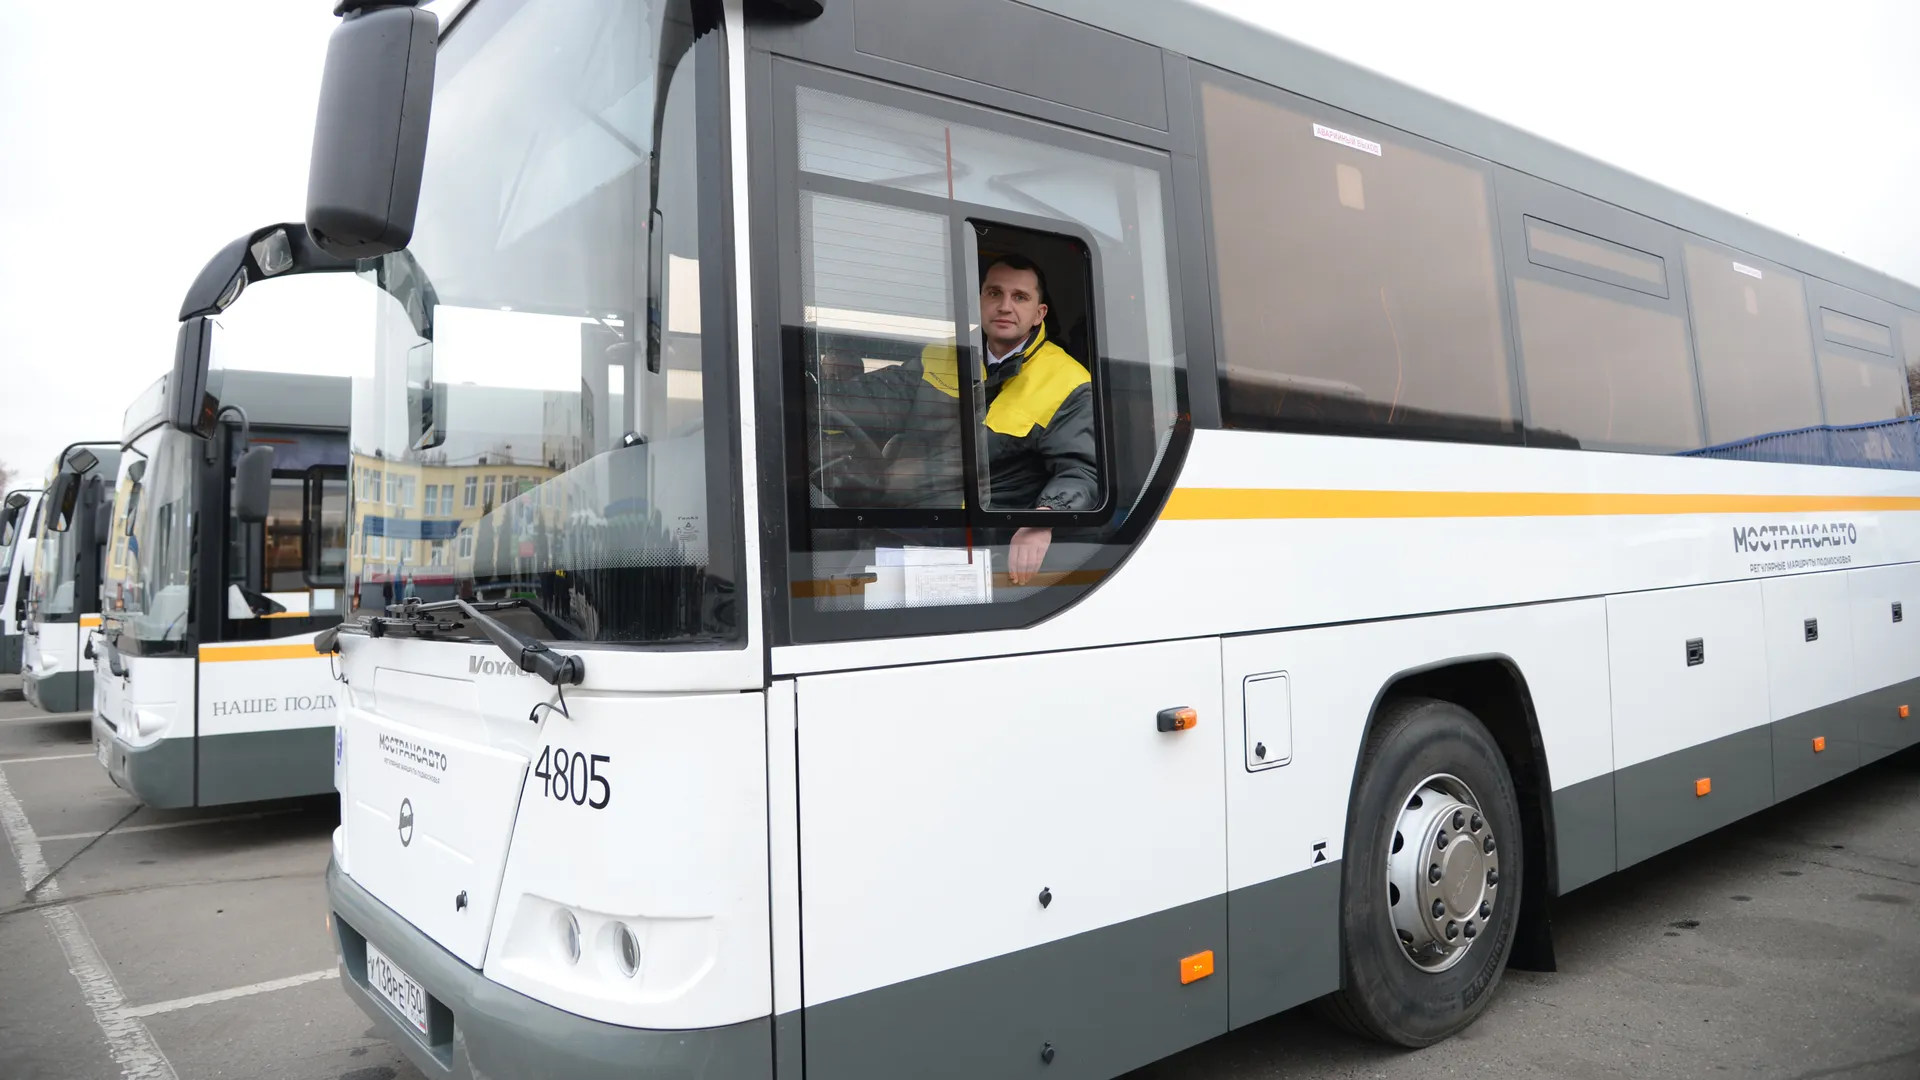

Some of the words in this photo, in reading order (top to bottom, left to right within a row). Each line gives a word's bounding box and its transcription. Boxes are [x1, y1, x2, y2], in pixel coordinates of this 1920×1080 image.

[1733, 522, 1857, 553] МОСТРАНСАВТО
[213, 698, 277, 716] НАШЕ
[379, 733, 447, 772] МОСТРАНСАВТО
[535, 745, 611, 810] 4805
